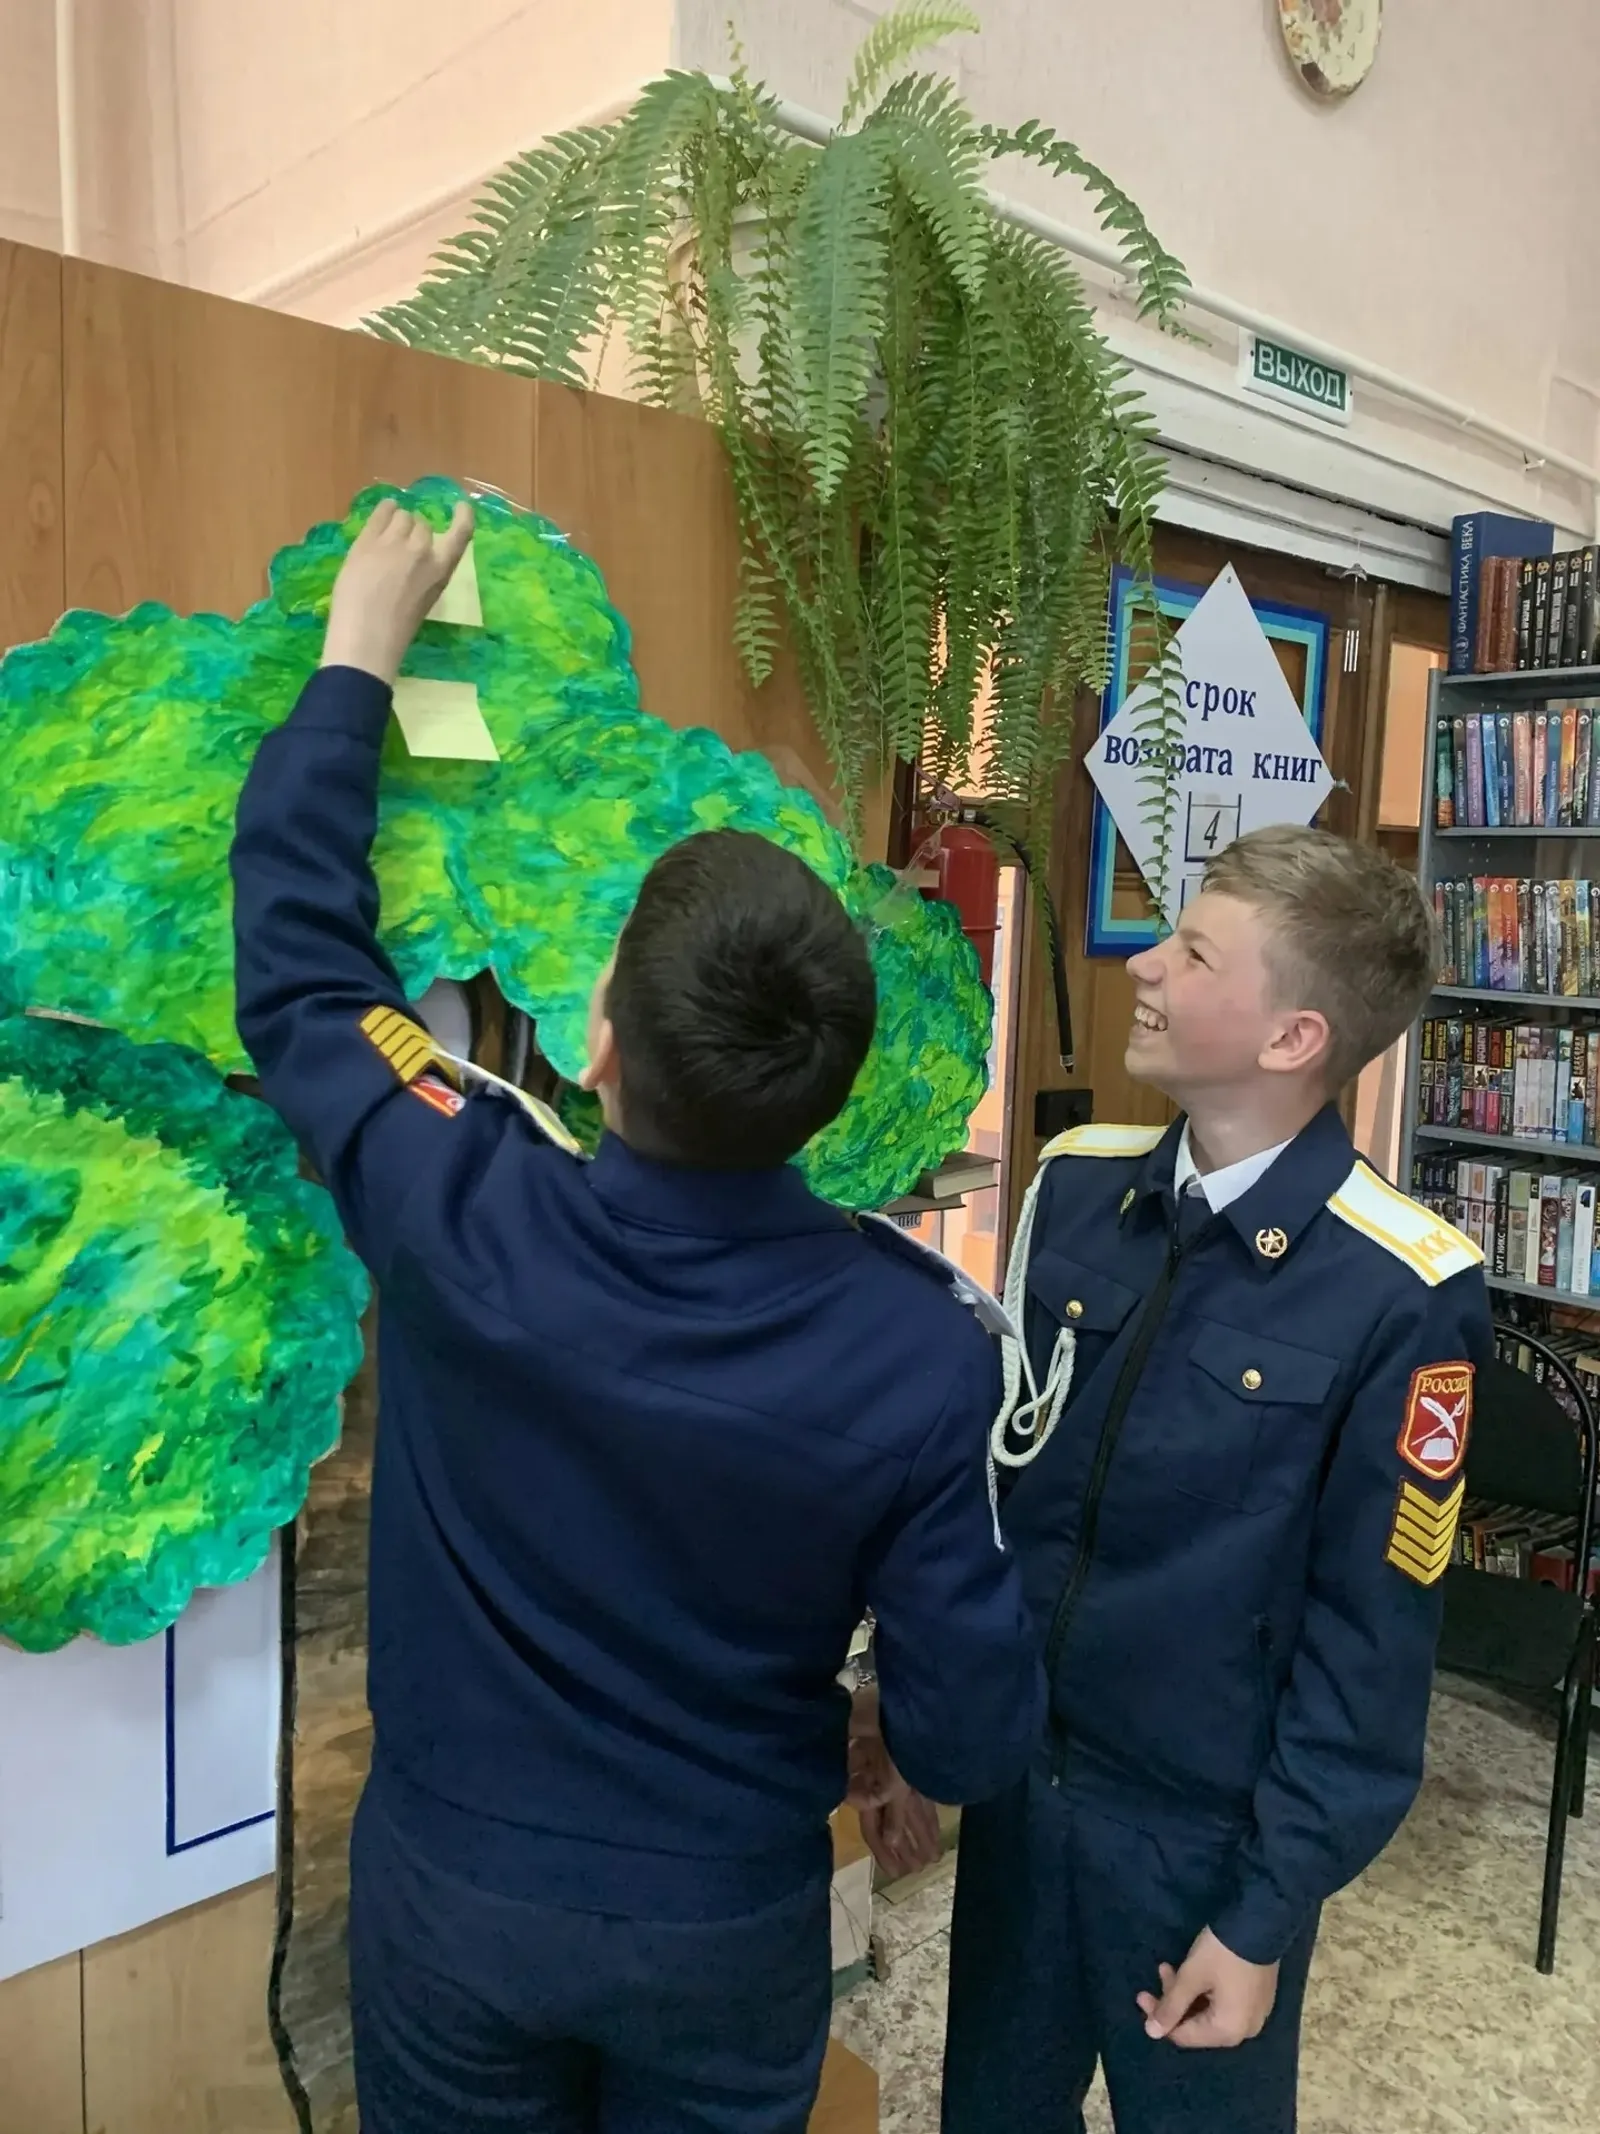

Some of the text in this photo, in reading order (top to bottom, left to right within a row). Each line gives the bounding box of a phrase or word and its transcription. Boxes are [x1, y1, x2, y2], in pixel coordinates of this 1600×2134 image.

[1258, 344, 1341, 406] ВЫХОД
[1457, 520, 1474, 633] ФАНТАСТИКА ВЕКА
[1186, 680, 1257, 721] срок
[1104, 735, 1322, 783] возрата книг
[1203, 809, 1222, 850] 4
